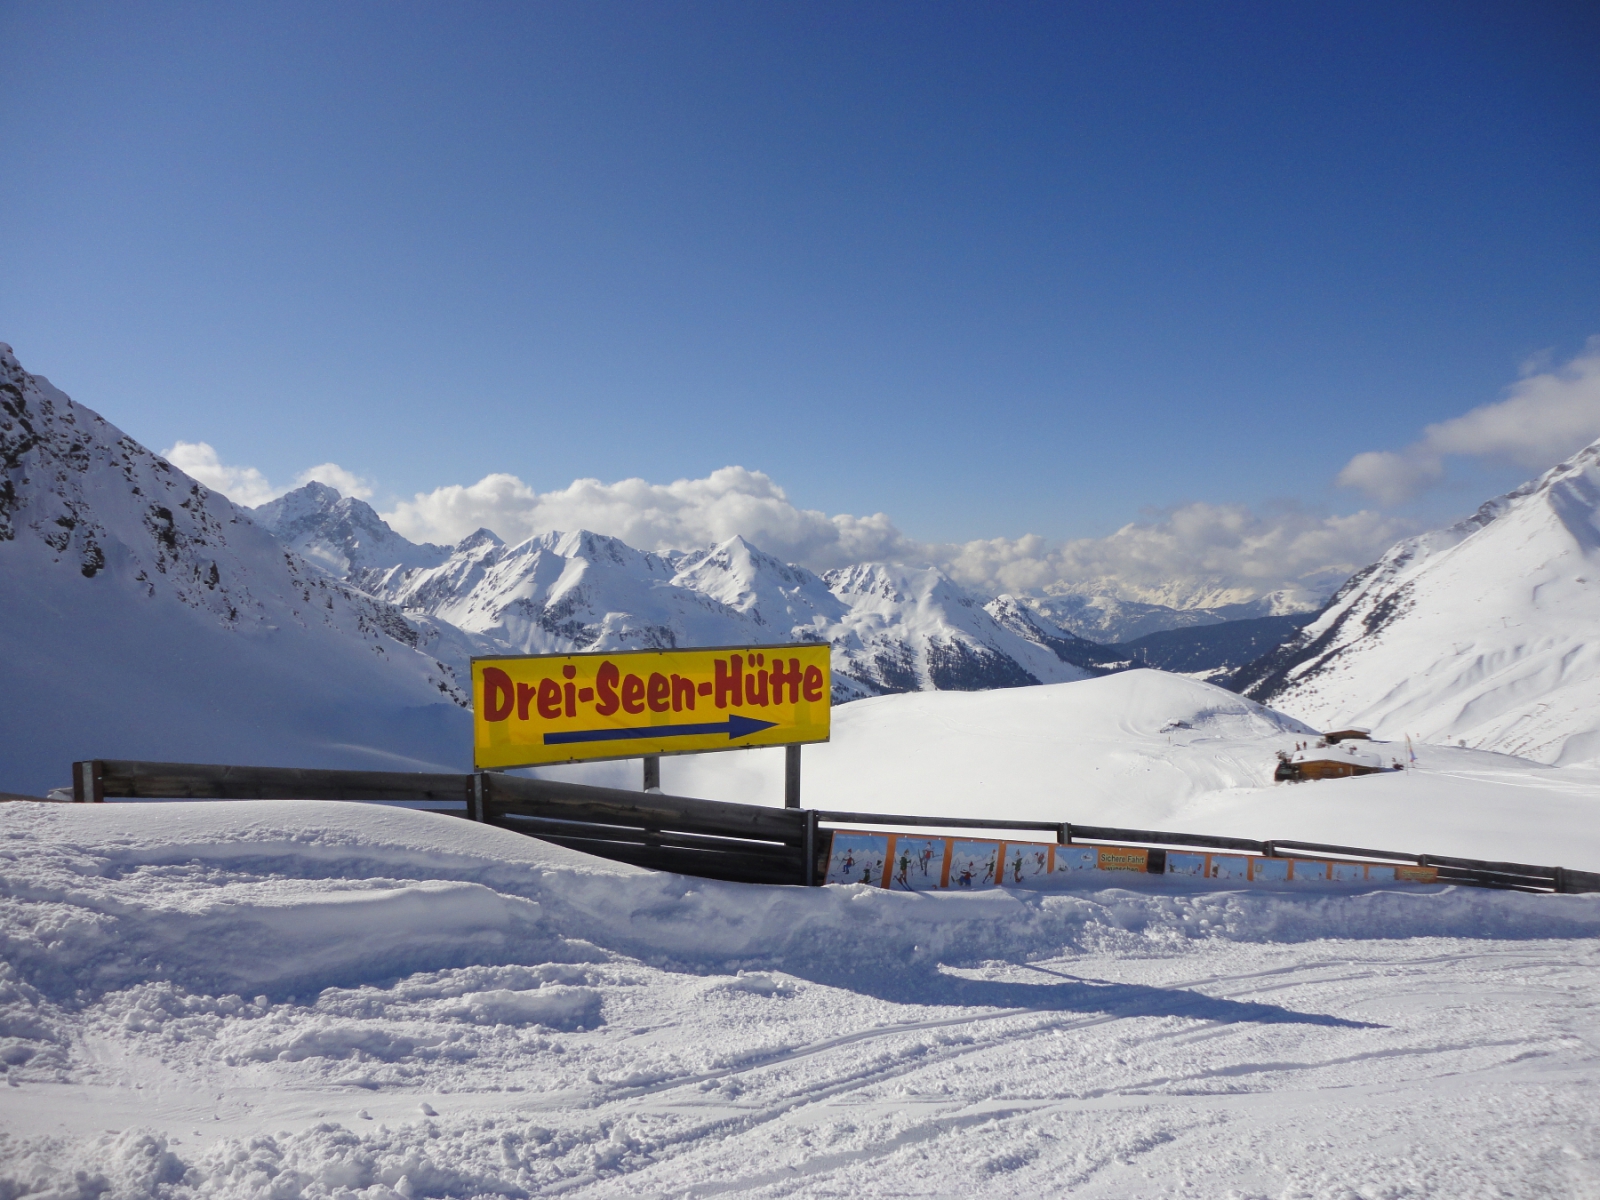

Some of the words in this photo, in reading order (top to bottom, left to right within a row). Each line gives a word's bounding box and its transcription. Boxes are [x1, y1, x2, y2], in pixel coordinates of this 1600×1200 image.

[483, 653, 823, 722] Drei-Seen-Hütte
[1101, 854, 1125, 862] Sichere
[1127, 855, 1144, 863] Fahrt
